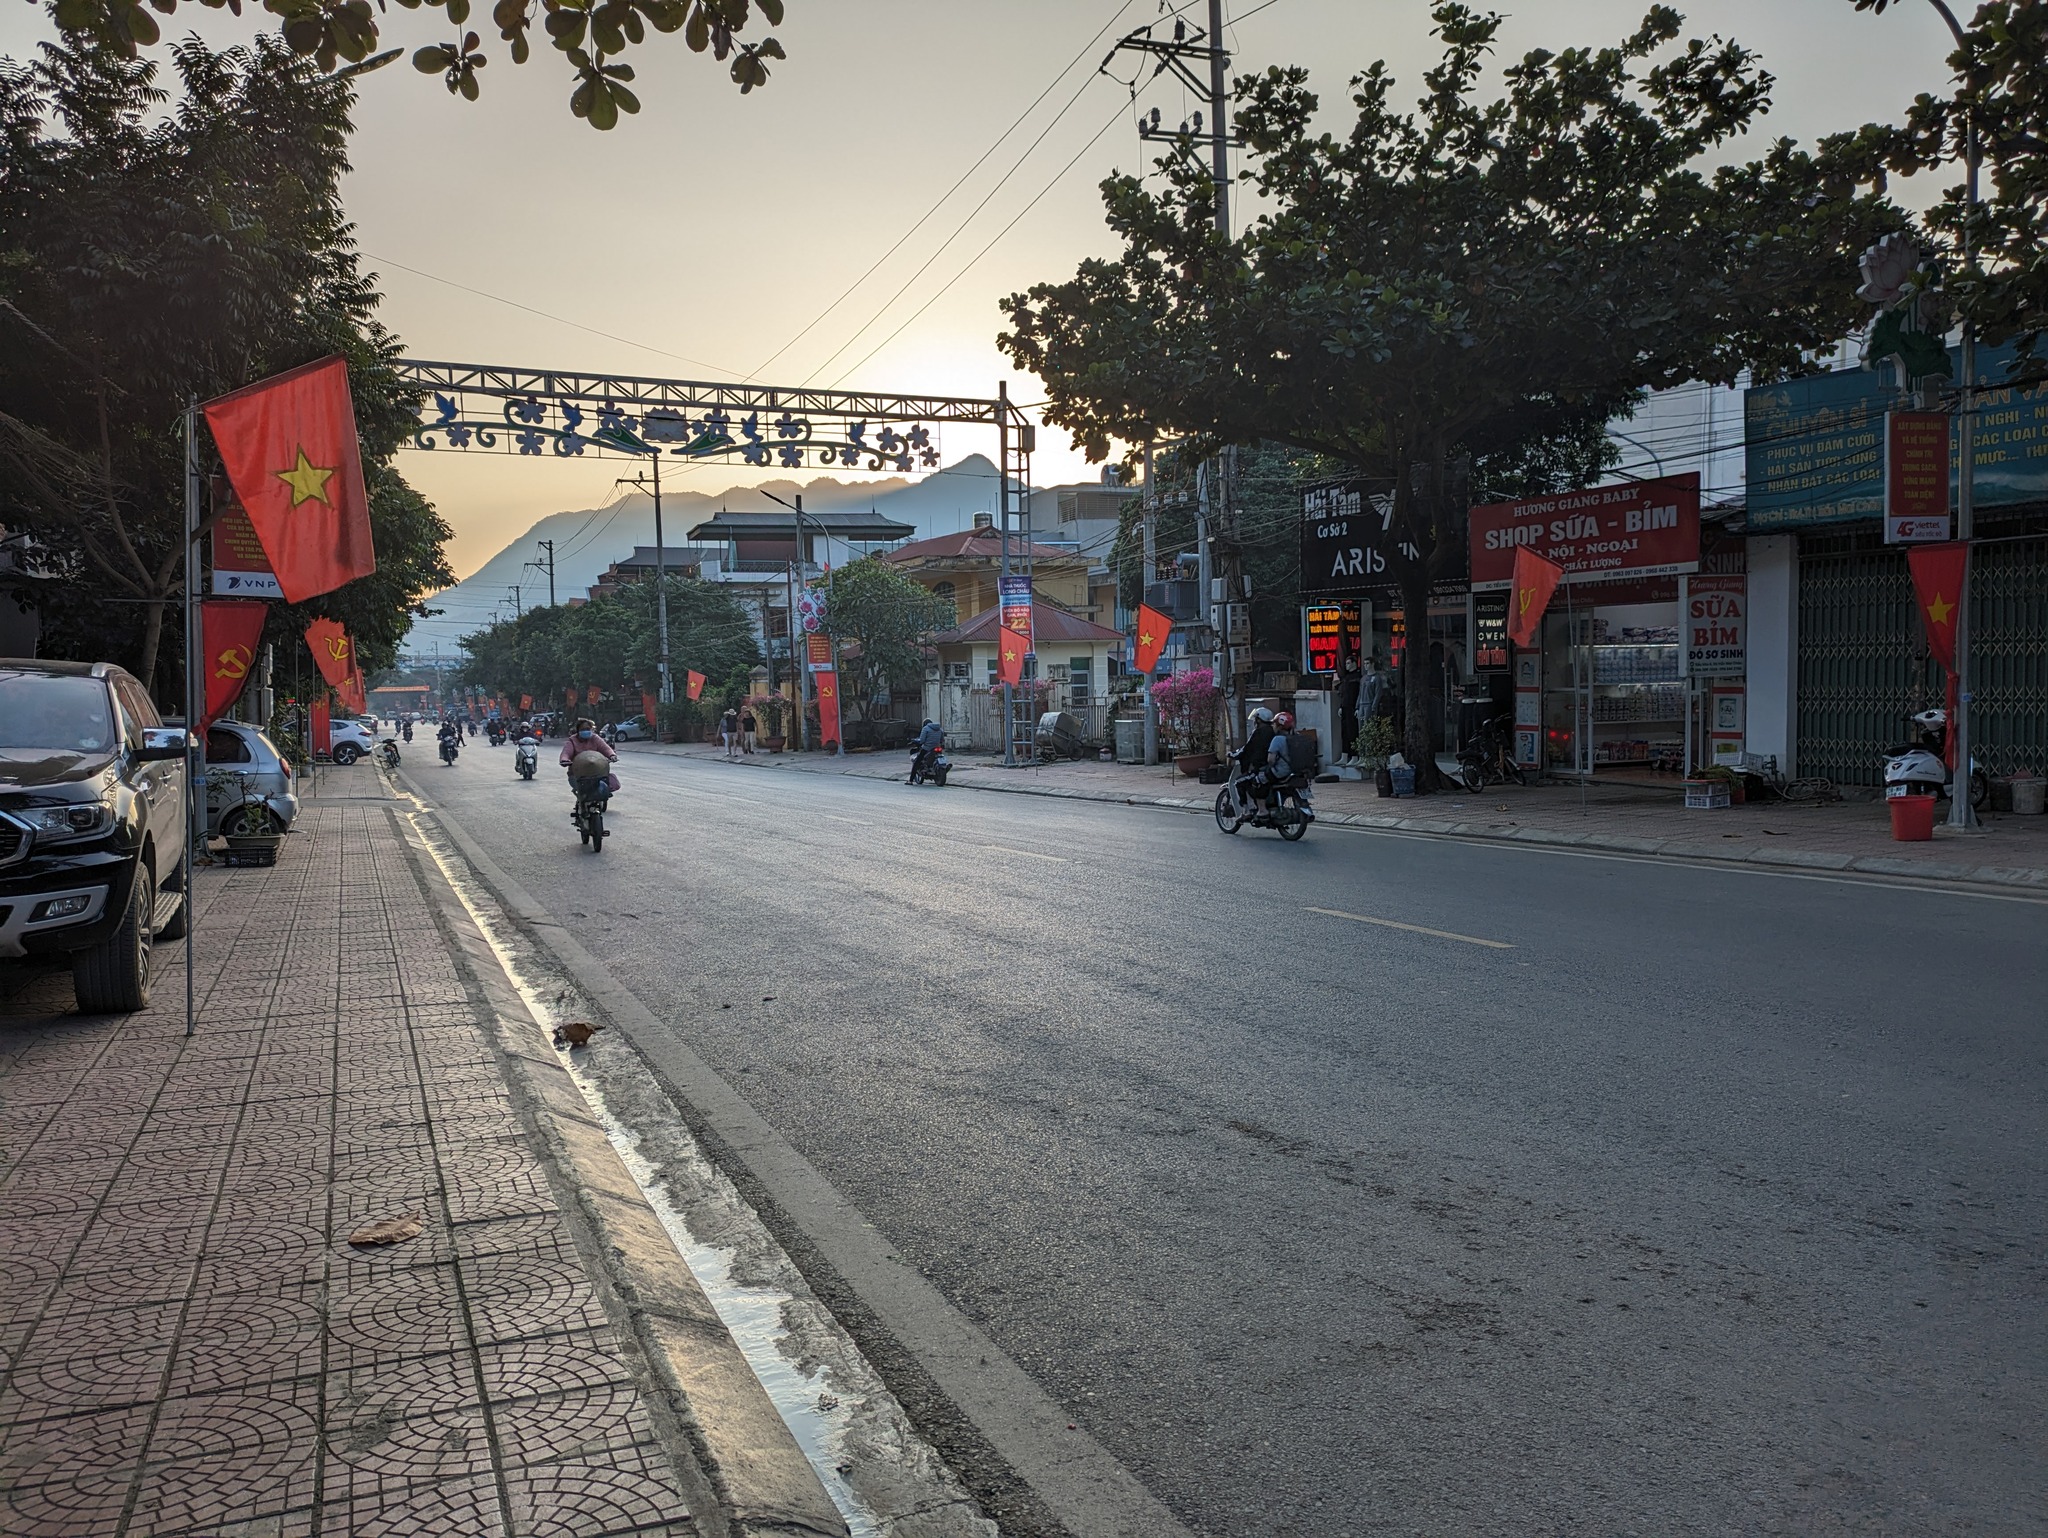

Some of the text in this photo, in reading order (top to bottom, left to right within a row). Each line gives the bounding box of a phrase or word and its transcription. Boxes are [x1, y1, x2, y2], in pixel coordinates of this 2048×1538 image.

[1985, 410, 2019, 427] NGHỊ
[1767, 447, 1796, 460] PHỤC
[1799, 444, 1813, 458] VỤ
[1847, 432, 1875, 448] CƯỚI
[1973, 432, 1999, 447] CÁC
[2004, 427, 2036, 442] LOẠI
[1514, 488, 1640, 517] HƯƠNG GIANG BABY
[1341, 521, 1348, 536] 2
[1485, 524, 1543, 550] SHOP
[1550, 513, 1599, 542] SỮA
[1625, 500, 1677, 532] BỈM
[1548, 544, 1575, 560] NỘI
[1586, 538, 1638, 555] NGOẠI
[1589, 557, 1622, 570] LƯỢNG
[1707, 552, 1744, 573] SINH
[245, 580, 276, 588] VNP
[1690, 594, 1741, 618] SỮA
[1478, 632, 1505, 640] OWEN
[1693, 620, 1738, 646] BỈM
[1720, 649, 1743, 658] SINH
